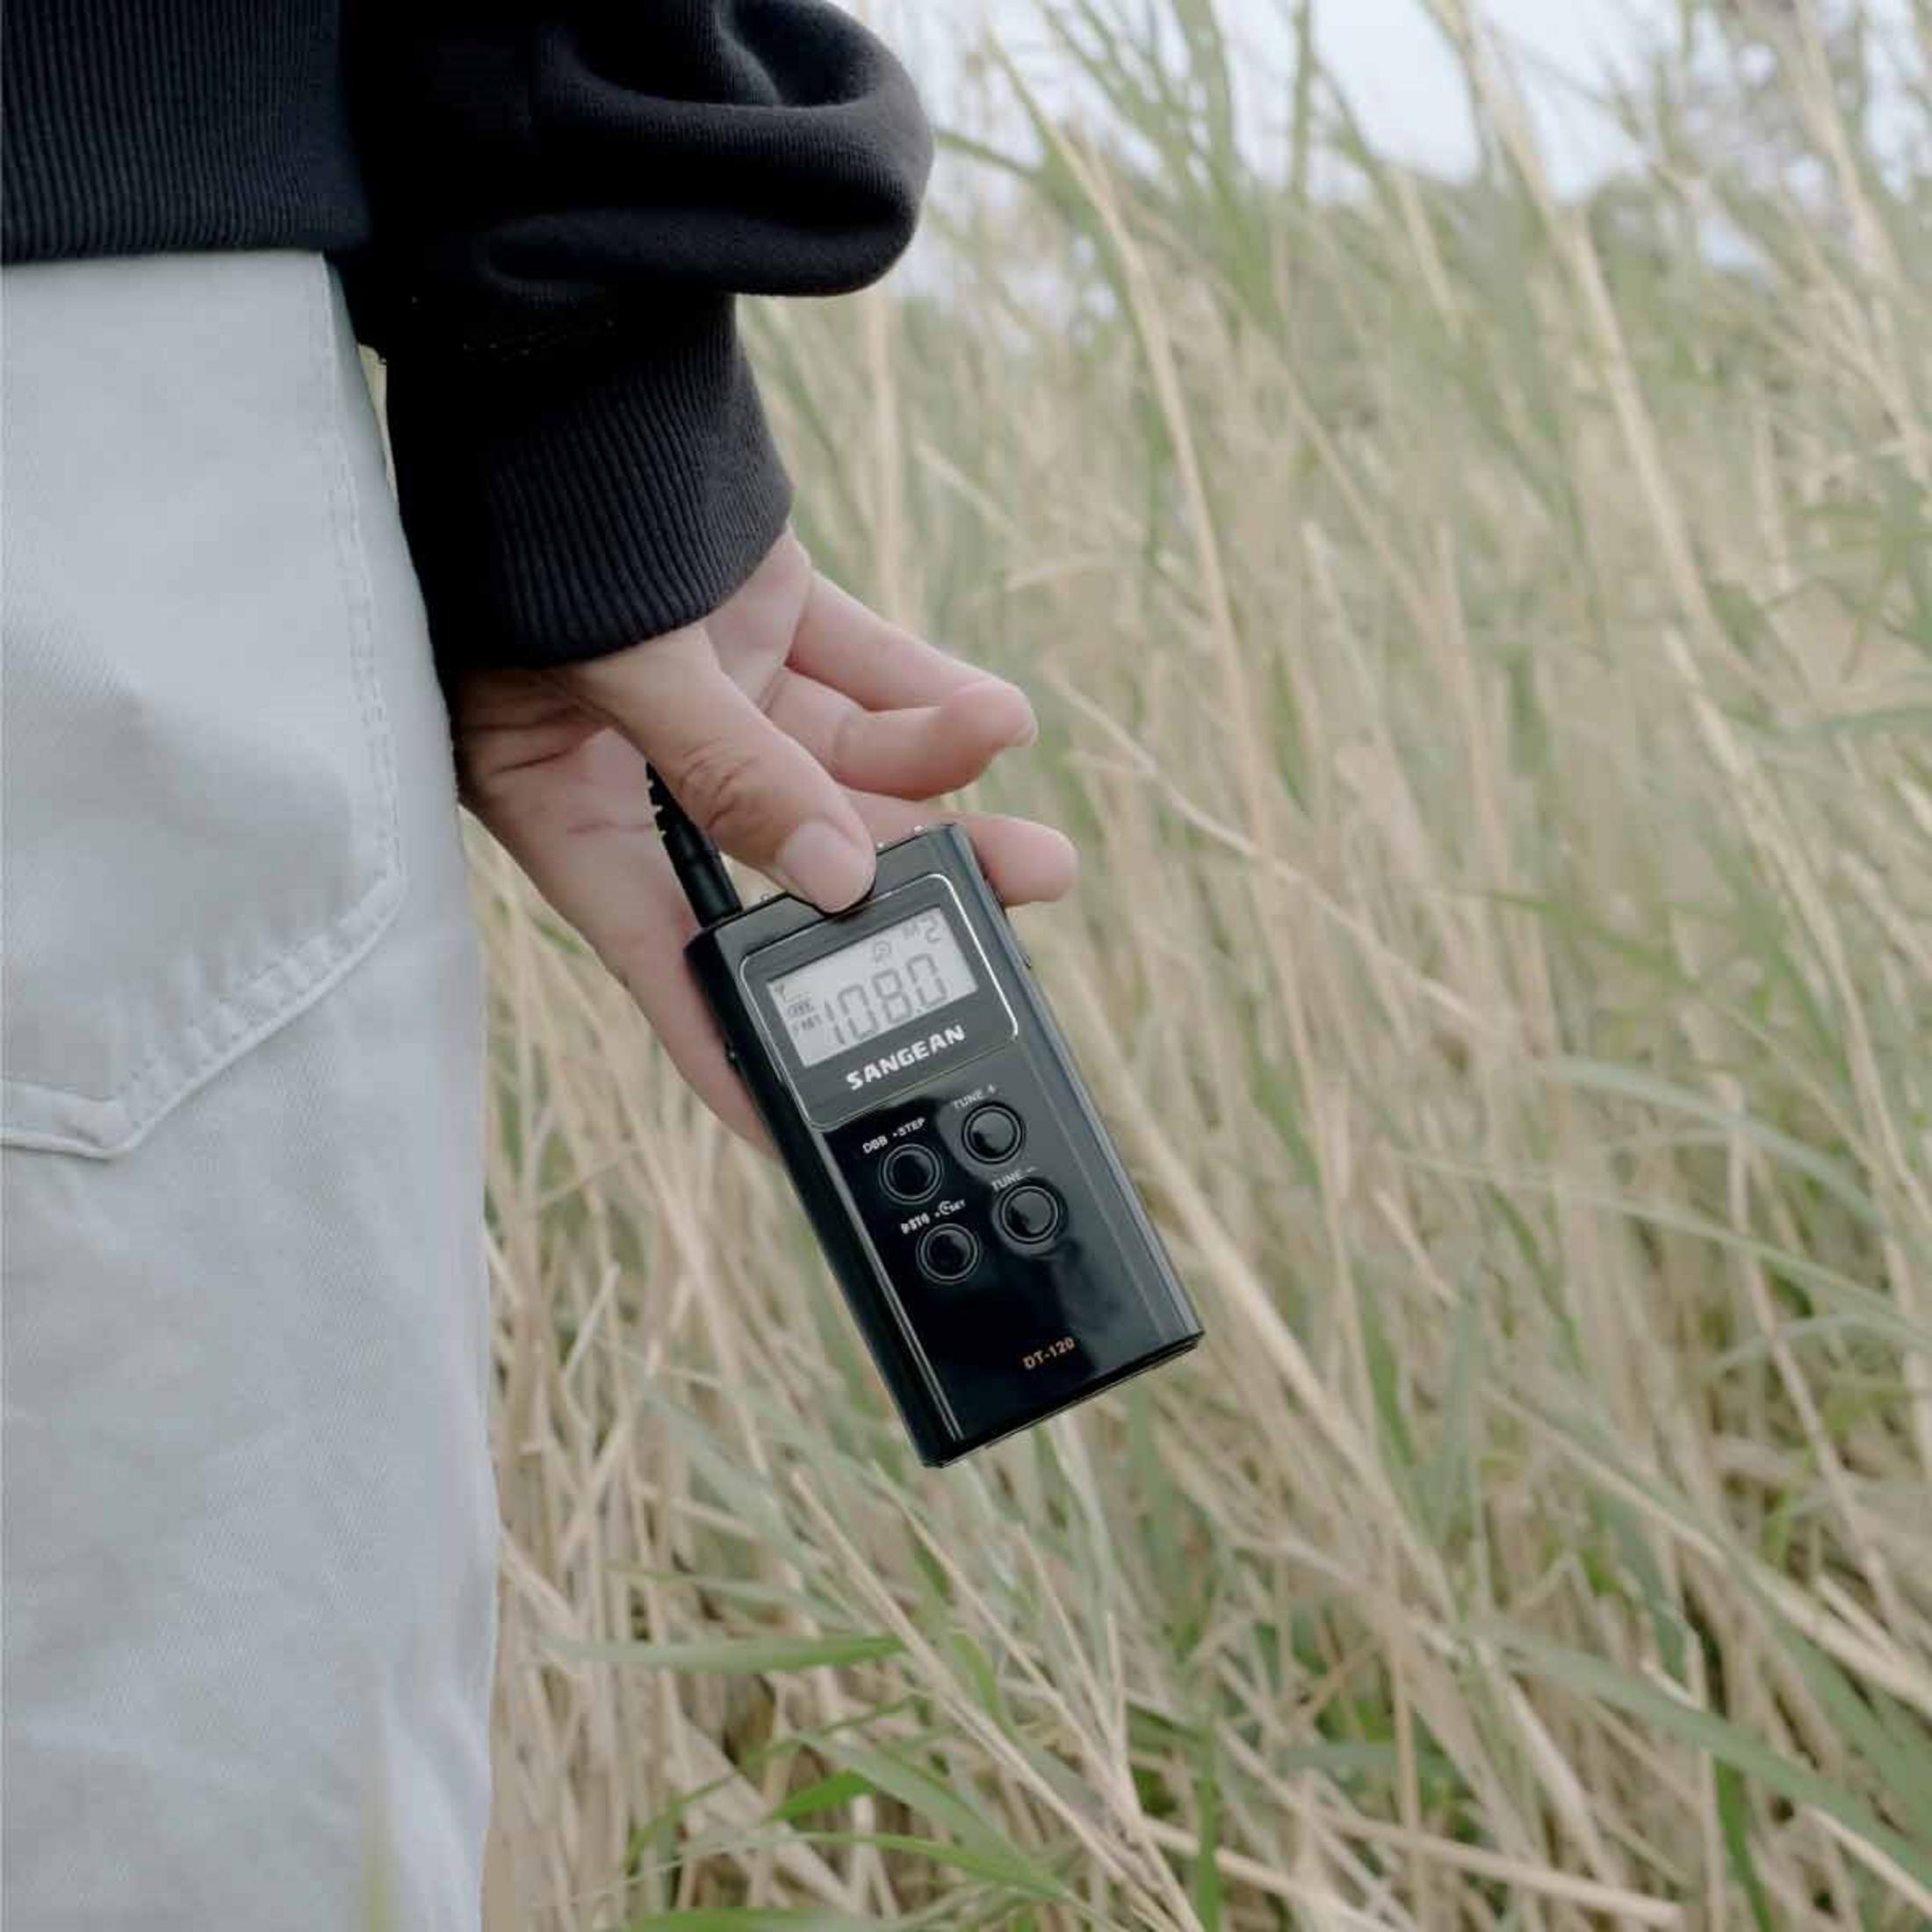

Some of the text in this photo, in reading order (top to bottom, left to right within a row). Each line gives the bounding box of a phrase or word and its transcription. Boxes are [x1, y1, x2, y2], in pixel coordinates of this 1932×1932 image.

[846, 1024, 966, 1091] SANGEAN
[952, 1089, 984, 1110] TUNE
[862, 1135, 889, 1154] DBB
[991, 1171, 1025, 1192] TUNE
[1022, 1337, 1076, 1370] DT-120
